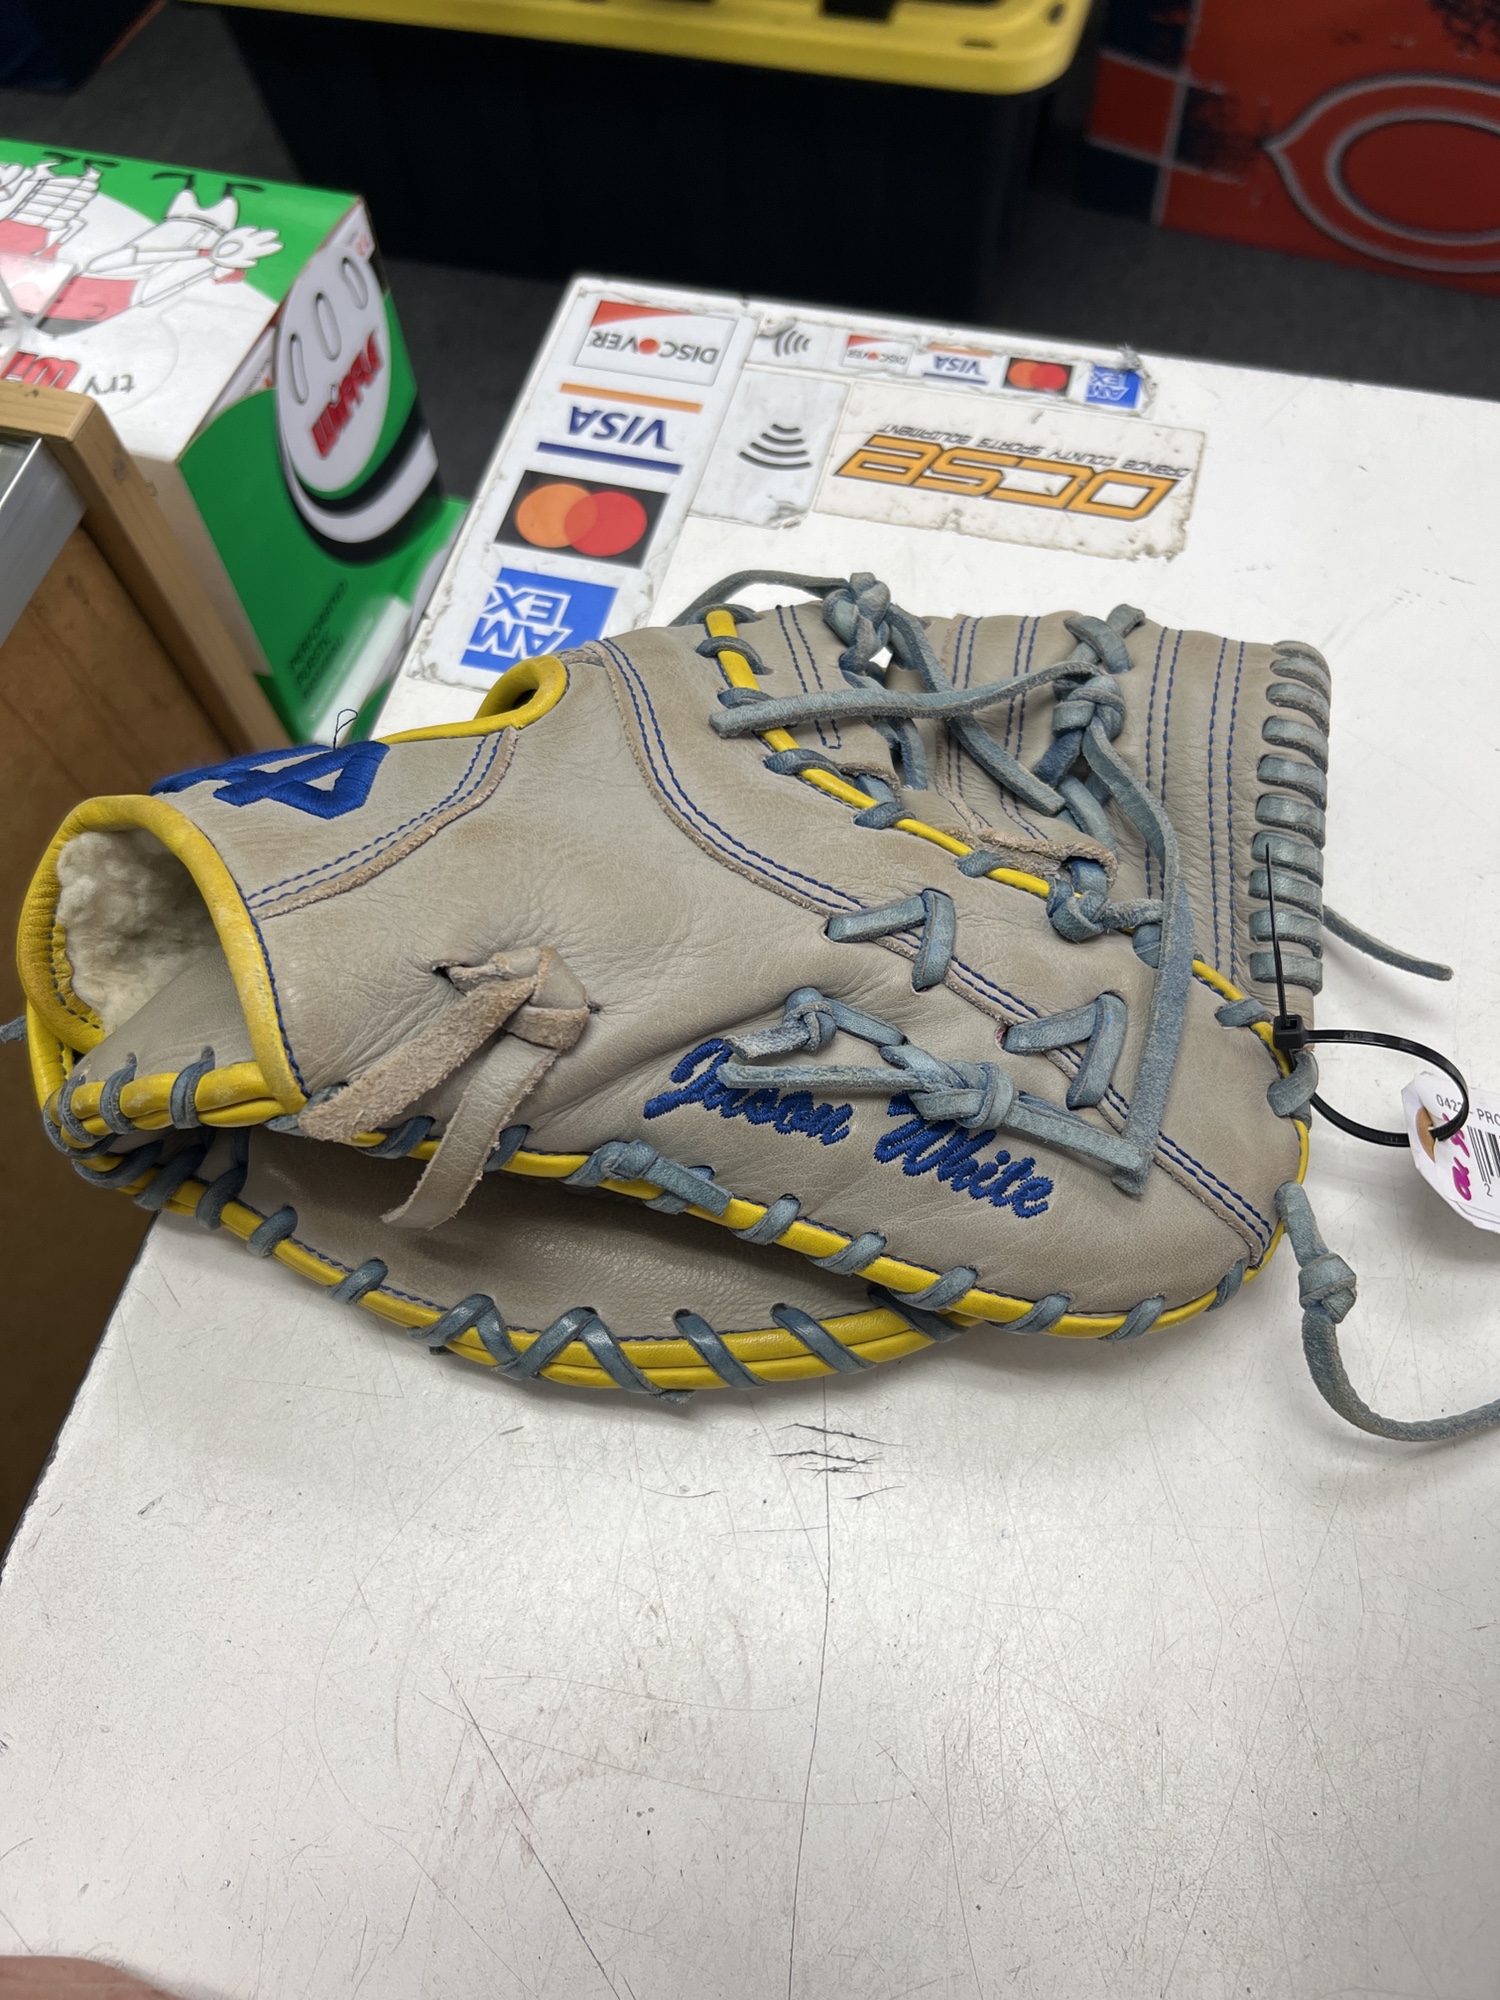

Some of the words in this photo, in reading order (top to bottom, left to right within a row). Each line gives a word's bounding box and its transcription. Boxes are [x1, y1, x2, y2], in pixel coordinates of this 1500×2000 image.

[588, 330, 720, 365] DISCOVER
[933, 355, 982, 376] VISA
[83, 374, 136, 394] try
[569, 406, 672, 451] VISA
[878, 424, 974, 446] EQUIPMENT
[977, 438, 1046, 456] SPORTS
[1049, 450, 1117, 468] COUNTY
[1122, 459, 1191, 479] ORANGE
[874, 1090, 1054, 1219] White
